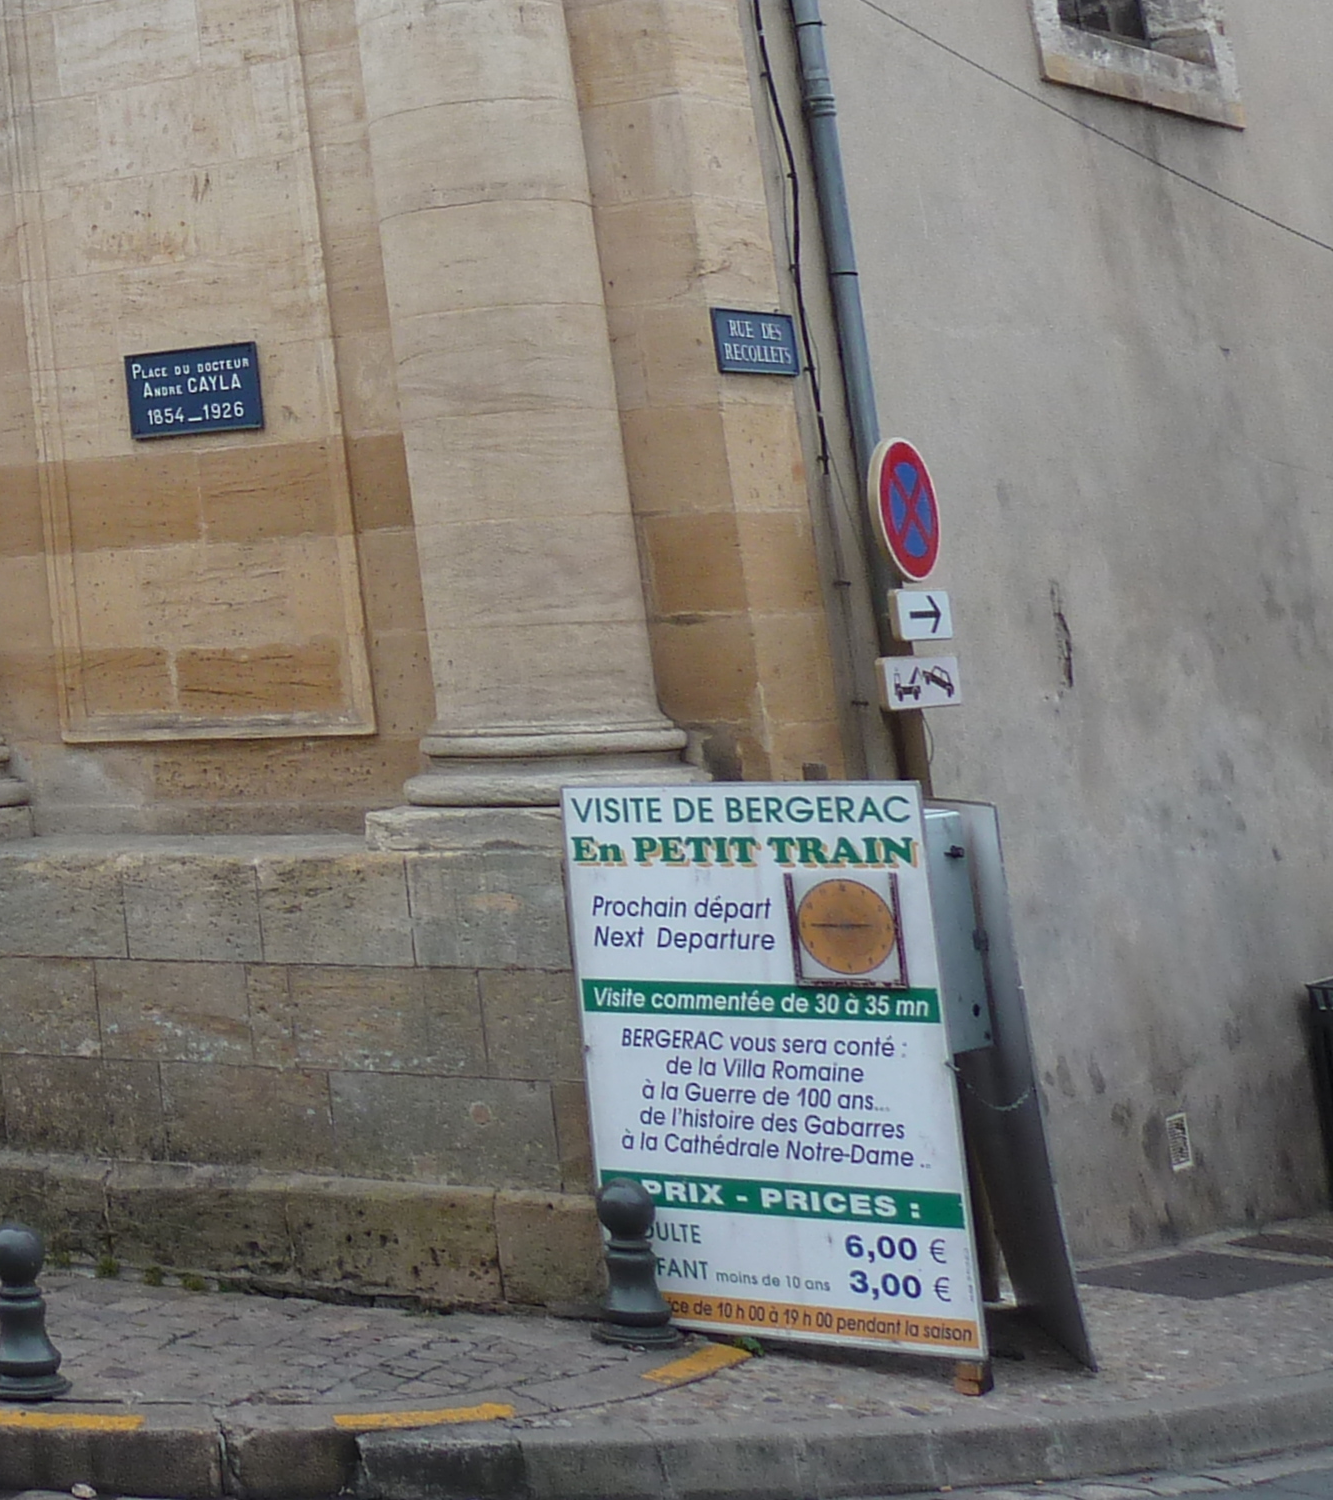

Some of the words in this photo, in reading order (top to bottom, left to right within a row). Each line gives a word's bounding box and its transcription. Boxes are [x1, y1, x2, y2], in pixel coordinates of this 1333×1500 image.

[728, 319, 755, 339] RUE
[761, 322, 782, 341] DES
[723, 342, 792, 365] RECOLLETS
[132, 363, 168, 380] PLACE
[174, 365, 190, 376] DU
[197, 357, 249, 374] DOCTEUR
[143, 382, 183, 399] ANDRE
[187, 373, 242, 393] CAYLA
[571, 797, 662, 822] VISITE
[674, 797, 716, 823] DE
[725, 796, 910, 823] BERGERAC
[571, 836, 625, 865] En
[632, 836, 759, 866] PETIT
[767, 836, 917, 867] TRAIN
[592, 895, 687, 918] Prochain
[694, 895, 771, 922] départ
[594, 926, 644, 948] Next
[657, 927, 775, 953] Departure
[593, 987, 645, 1007] Visite
[651, 990, 774, 1012] commentée
[781, 993, 809, 1013] de
[815, 994, 839, 1014] 30
[845, 992, 860, 1015] à
[864, 996, 889, 1016] 35
[896, 1000, 930, 1017] mn
[622, 1028, 724, 1051] BERGERAC
[730, 1036, 776, 1053] vous
[782, 1039, 827, 1055] sera
[833, 1035, 895, 1057] conté
[666, 1056, 693, 1076] de
[698, 1056, 717, 1077] la
[723, 1058, 766, 1079] Villa
[772, 1060, 865, 1083] Romaine
[641, 1078, 655, 1100] à
[660, 1080, 678, 1101] la
[685, 1083, 757, 1105] Guerre
[763, 1085, 790, 1107] de
[797, 1088, 832, 1109] 100
[639, 1107, 666, 1126] de
[671, 1107, 755, 1131] l'histoire
[761, 1112, 798, 1134] des
[804, 1115, 905, 1139] Gabarres
[622, 1128, 634, 1151] à
[640, 1131, 658, 1151] la
[664, 1133, 780, 1159] Cathédrale
[786, 1140, 914, 1168] Notre-Dame
[641, 1179, 725, 1205] PRIX
[760, 1187, 898, 1218] PRICES
[845, 1234, 918, 1264] 6,00
[929, 1237, 947, 1264] €
[716, 1271, 758, 1285] moins
[762, 1274, 780, 1287] de
[785, 1275, 801, 1289] 10
[804, 1280, 831, 1292] ans
[849, 1269, 922, 1301] 3,00
[933, 1276, 952, 1303] €
[693, 1300, 712, 1316] de
[717, 1303, 733, 1318] 10
[736, 1304, 745, 1319] h
[748, 1305, 765, 1322] 00
[769, 1304, 779, 1323] à
[783, 1309, 799, 1325] 19
[803, 1310, 811, 1326] h
[816, 1311, 833, 1328] 00
[837, 1315, 901, 1335] pendant
[905, 1320, 919, 1337] la
[923, 1323, 973, 1342] saison
